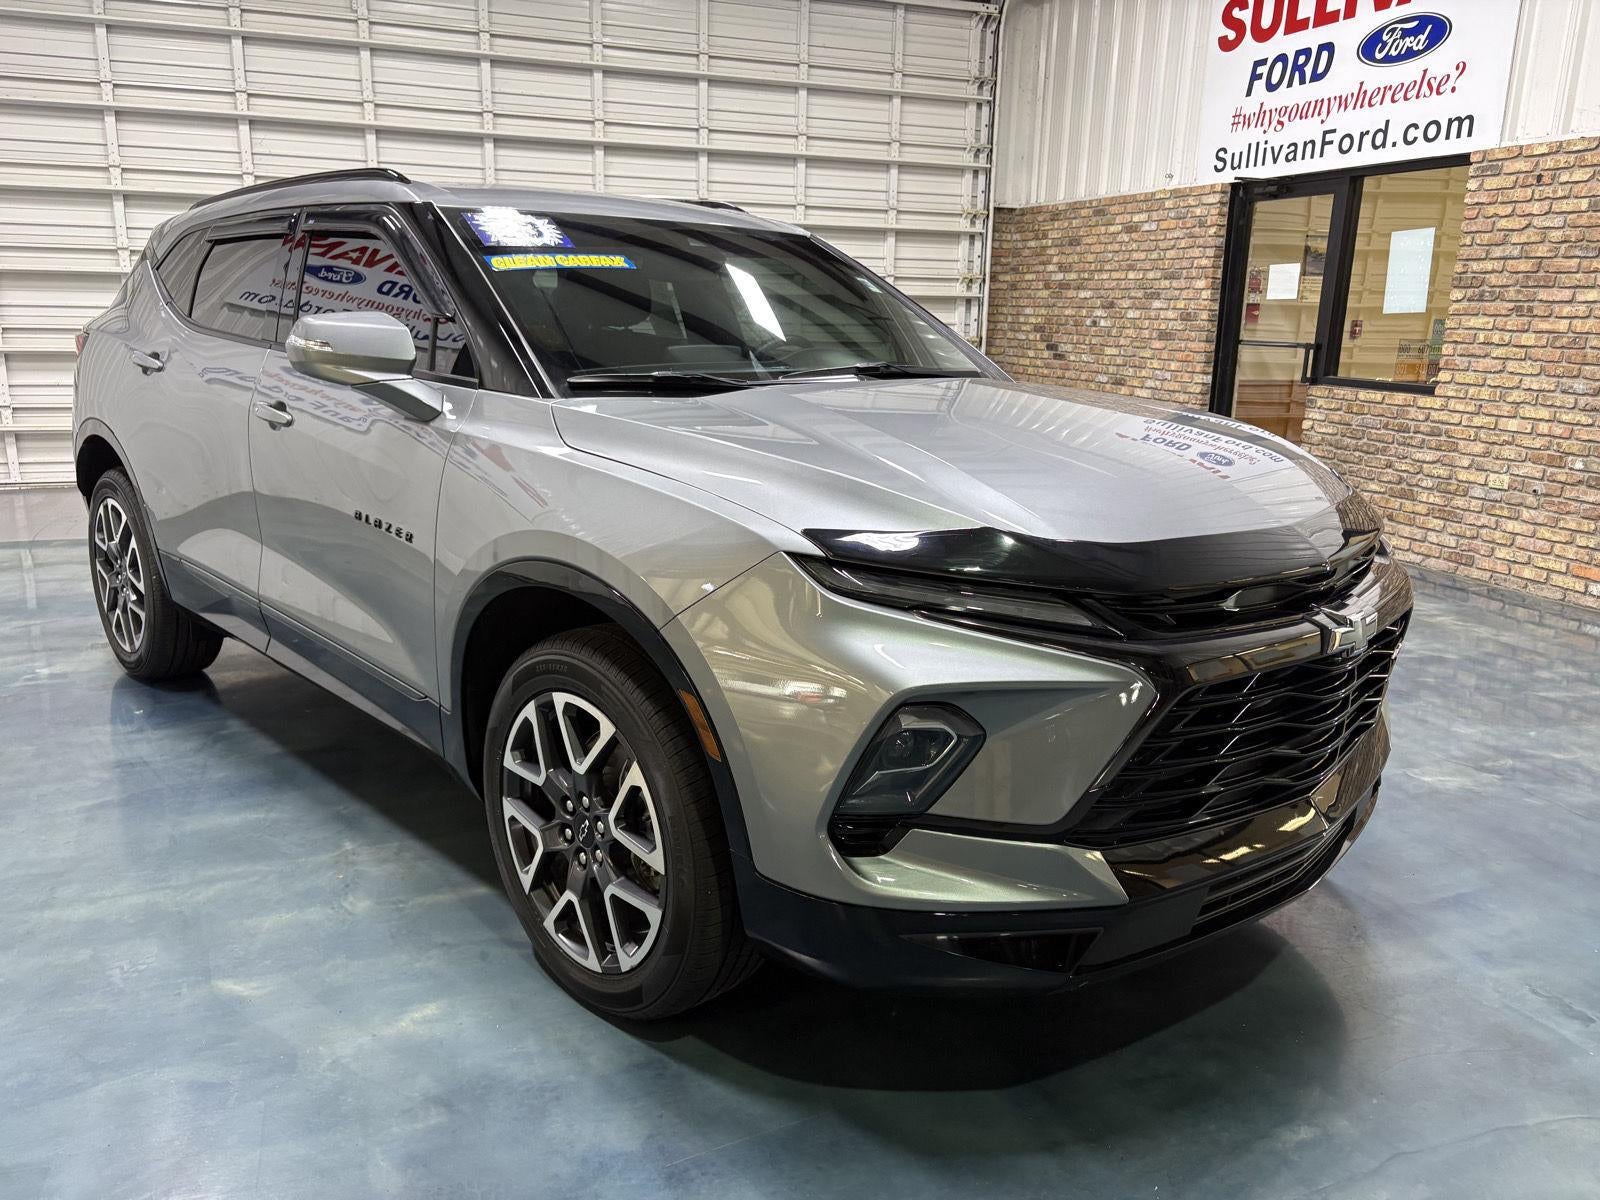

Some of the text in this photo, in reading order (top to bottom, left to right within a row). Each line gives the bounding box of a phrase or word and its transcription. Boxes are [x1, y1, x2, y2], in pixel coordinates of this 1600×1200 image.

[1374, 20, 1431, 61] Ford
[1245, 41, 1336, 97] FORD
[1230, 61, 1467, 134] #whygoanywhereelse?
[1213, 113, 1475, 173] SullivanFord.com
[491, 254, 628, 269] CLEAN CARFAX
[354, 509, 414, 544] BLAZER
